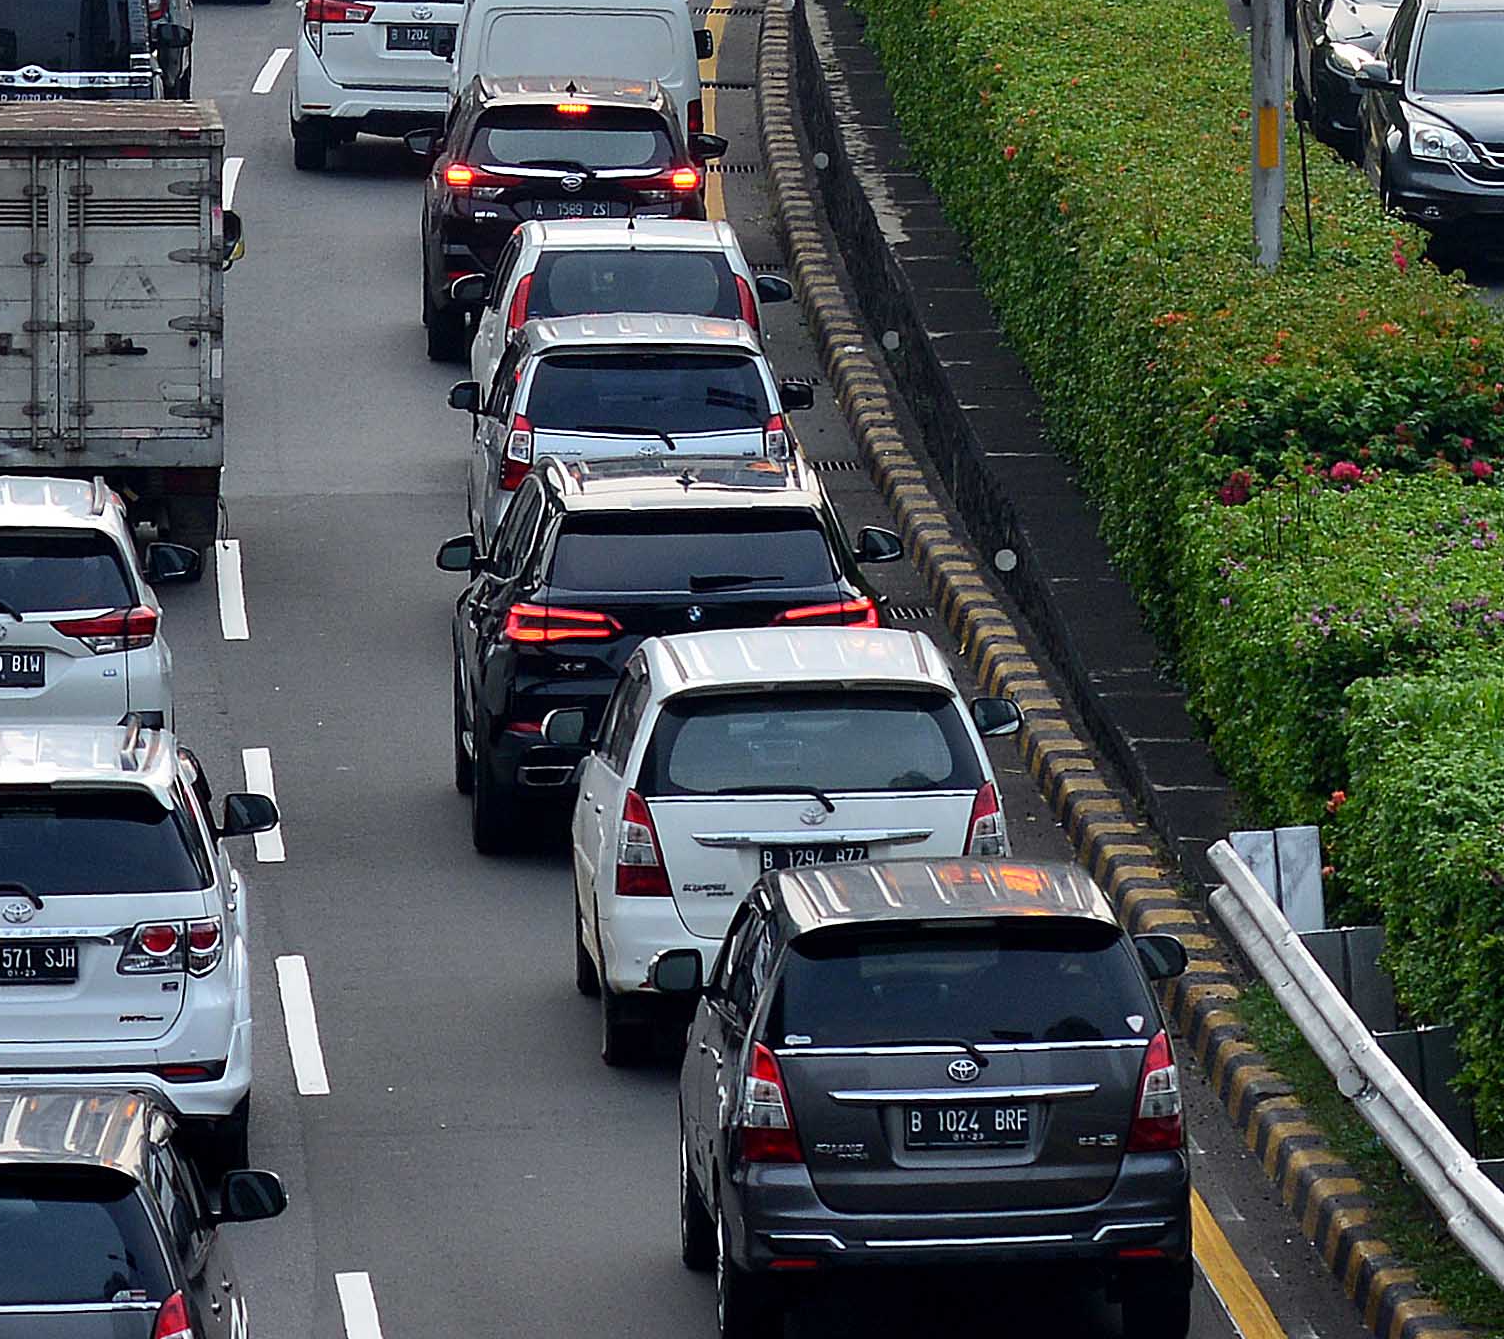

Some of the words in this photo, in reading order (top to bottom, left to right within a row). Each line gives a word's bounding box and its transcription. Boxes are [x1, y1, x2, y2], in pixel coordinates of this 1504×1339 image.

[391, 29, 398, 41] B
[406, 28, 429, 41] 1204
[535, 204, 544, 216] A
[558, 204, 584, 216] 1589
[11, 654, 41, 672] BIW
[763, 850, 774, 870] B
[43, 947, 76, 969] SJH
[911, 1112, 922, 1133] B
[936, 1110, 979, 1133] 1024
[995, 1109, 1029, 1132] BRF
